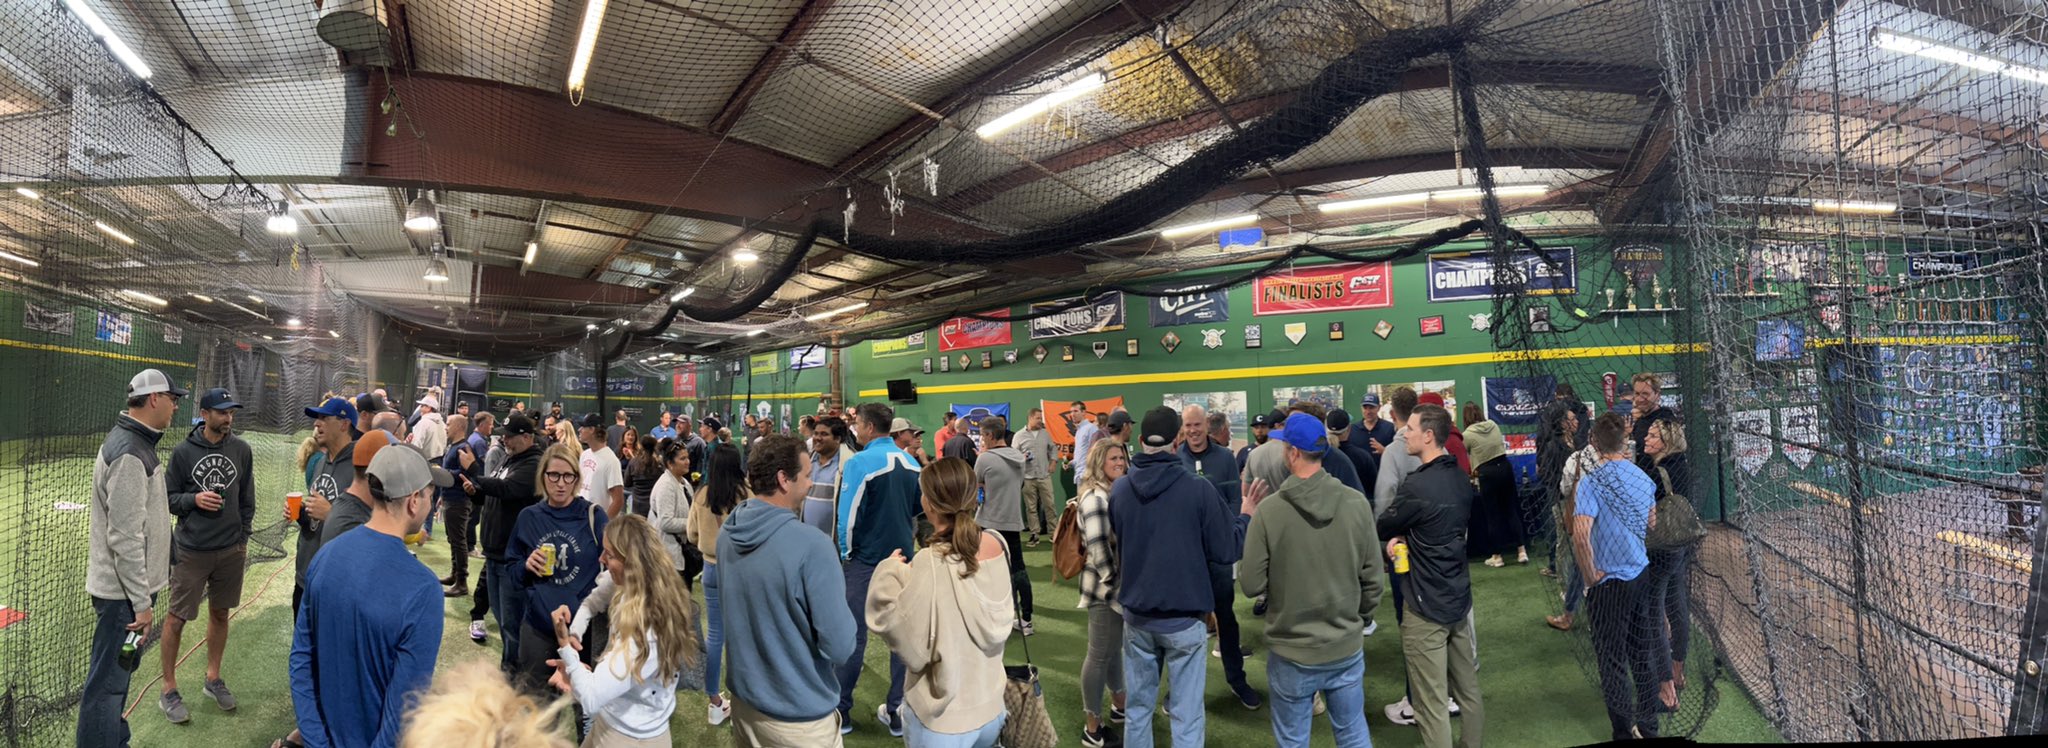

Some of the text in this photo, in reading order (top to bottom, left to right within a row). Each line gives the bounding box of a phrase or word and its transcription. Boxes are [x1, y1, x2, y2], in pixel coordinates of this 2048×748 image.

[1263, 280, 1345, 304] FINALISTS
[1034, 310, 1092, 330] CHAMPIONS
[194, 457, 235, 477] MAGNOLIA
[209, 475, 221, 483] THE
